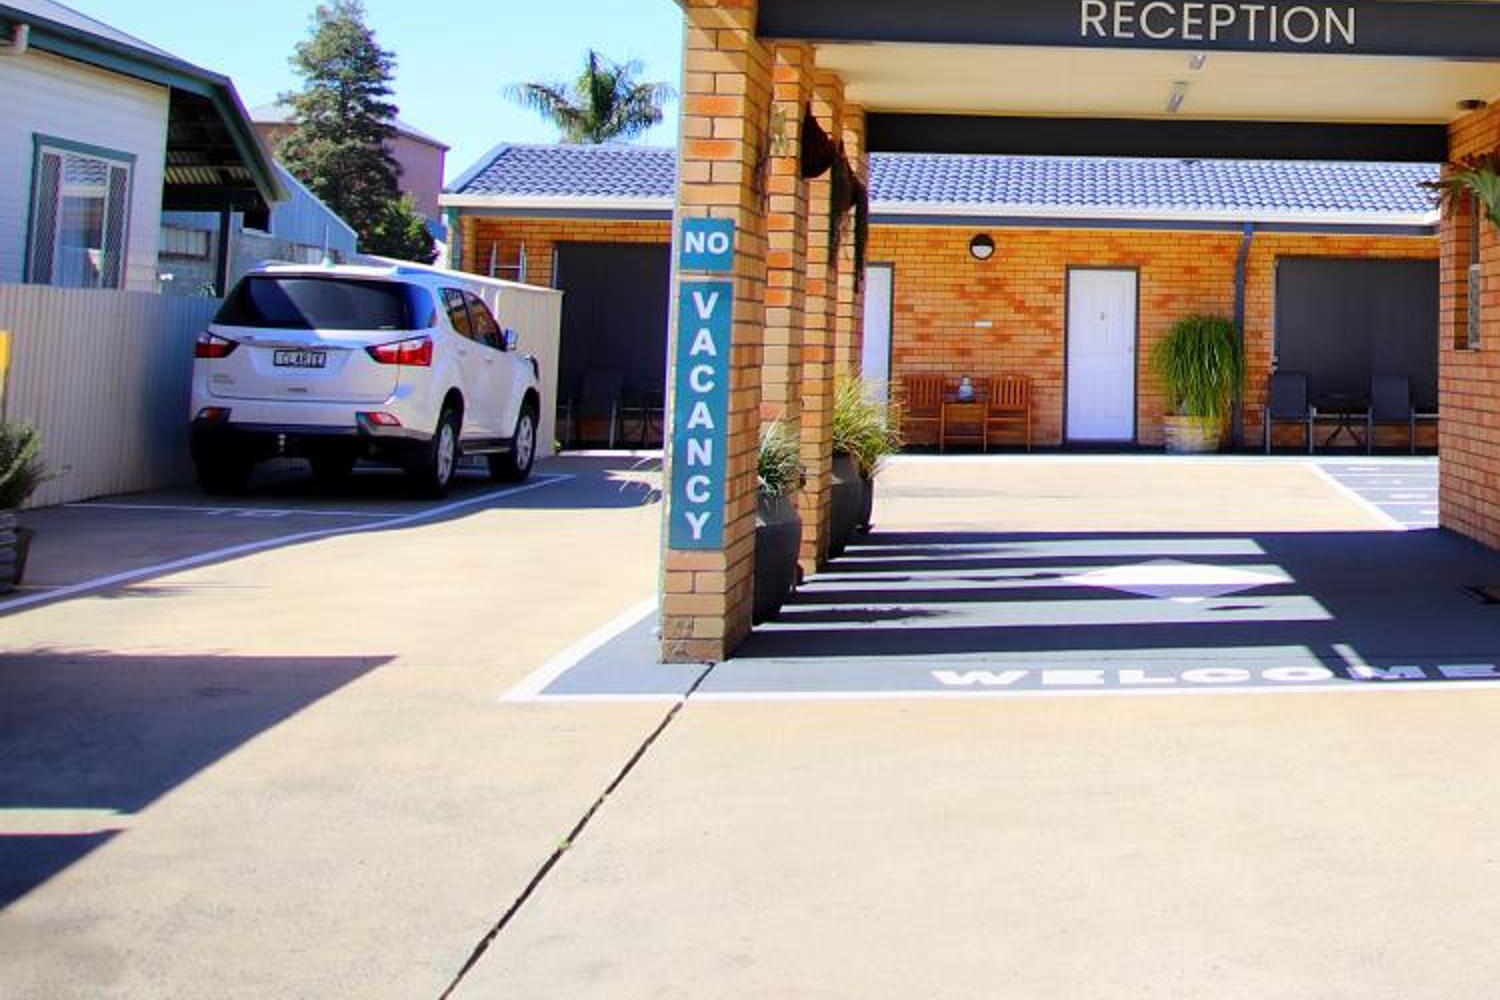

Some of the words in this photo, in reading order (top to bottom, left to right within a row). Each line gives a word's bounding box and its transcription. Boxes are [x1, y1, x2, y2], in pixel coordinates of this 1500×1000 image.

[1080, 0, 1355, 45] RECEPTION
[684, 231, 729, 255] NO
[684, 291, 719, 540] VACANCY
